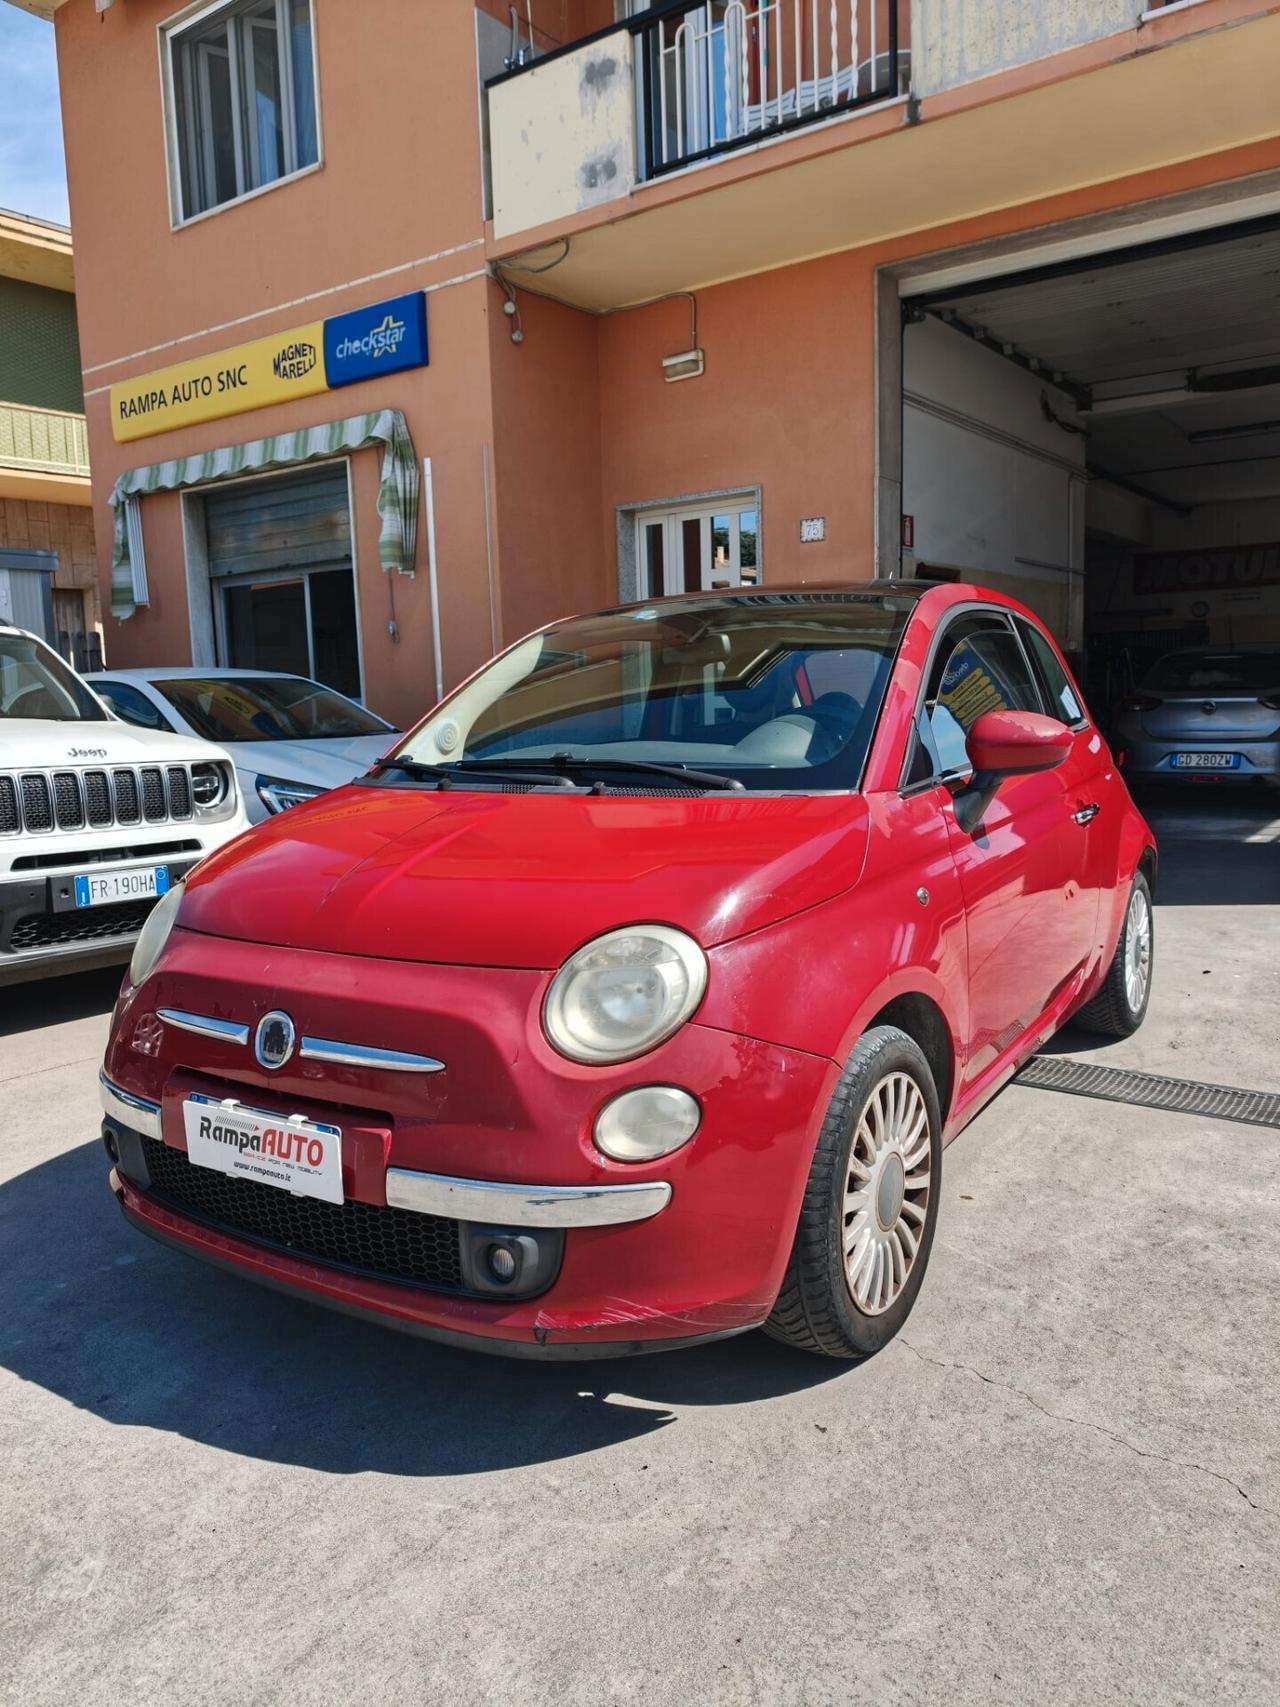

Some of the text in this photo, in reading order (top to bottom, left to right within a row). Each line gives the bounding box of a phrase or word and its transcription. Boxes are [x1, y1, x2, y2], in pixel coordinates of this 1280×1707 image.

[336, 326, 406, 359] checkstar
[119, 365, 248, 419] RAMPA AUTO SNC
[807, 523, 819, 537] 75
[67, 747, 107, 758] Jeep
